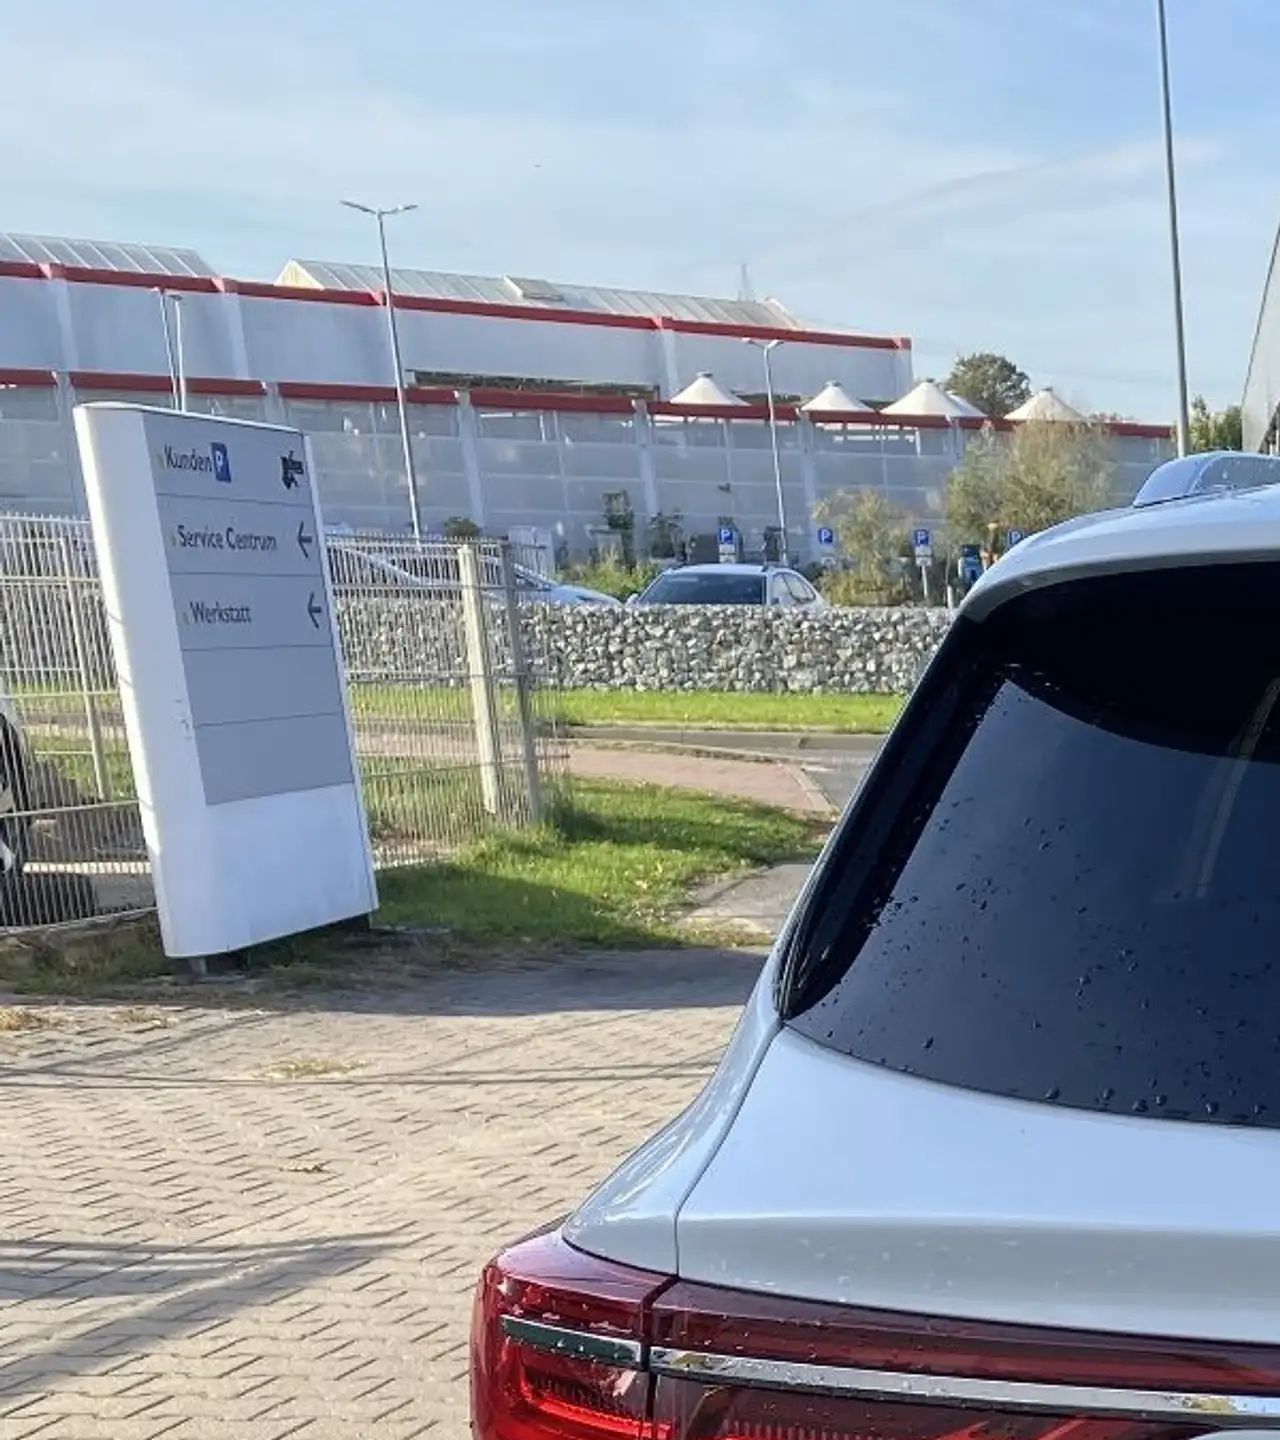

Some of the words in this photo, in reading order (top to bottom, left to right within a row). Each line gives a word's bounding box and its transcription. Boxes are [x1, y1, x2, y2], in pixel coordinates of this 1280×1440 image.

[164, 444, 213, 473] Kunden
[177, 523, 224, 550] Service
[226, 526, 278, 551] Centrum
[189, 601, 252, 624] Werkstatt
